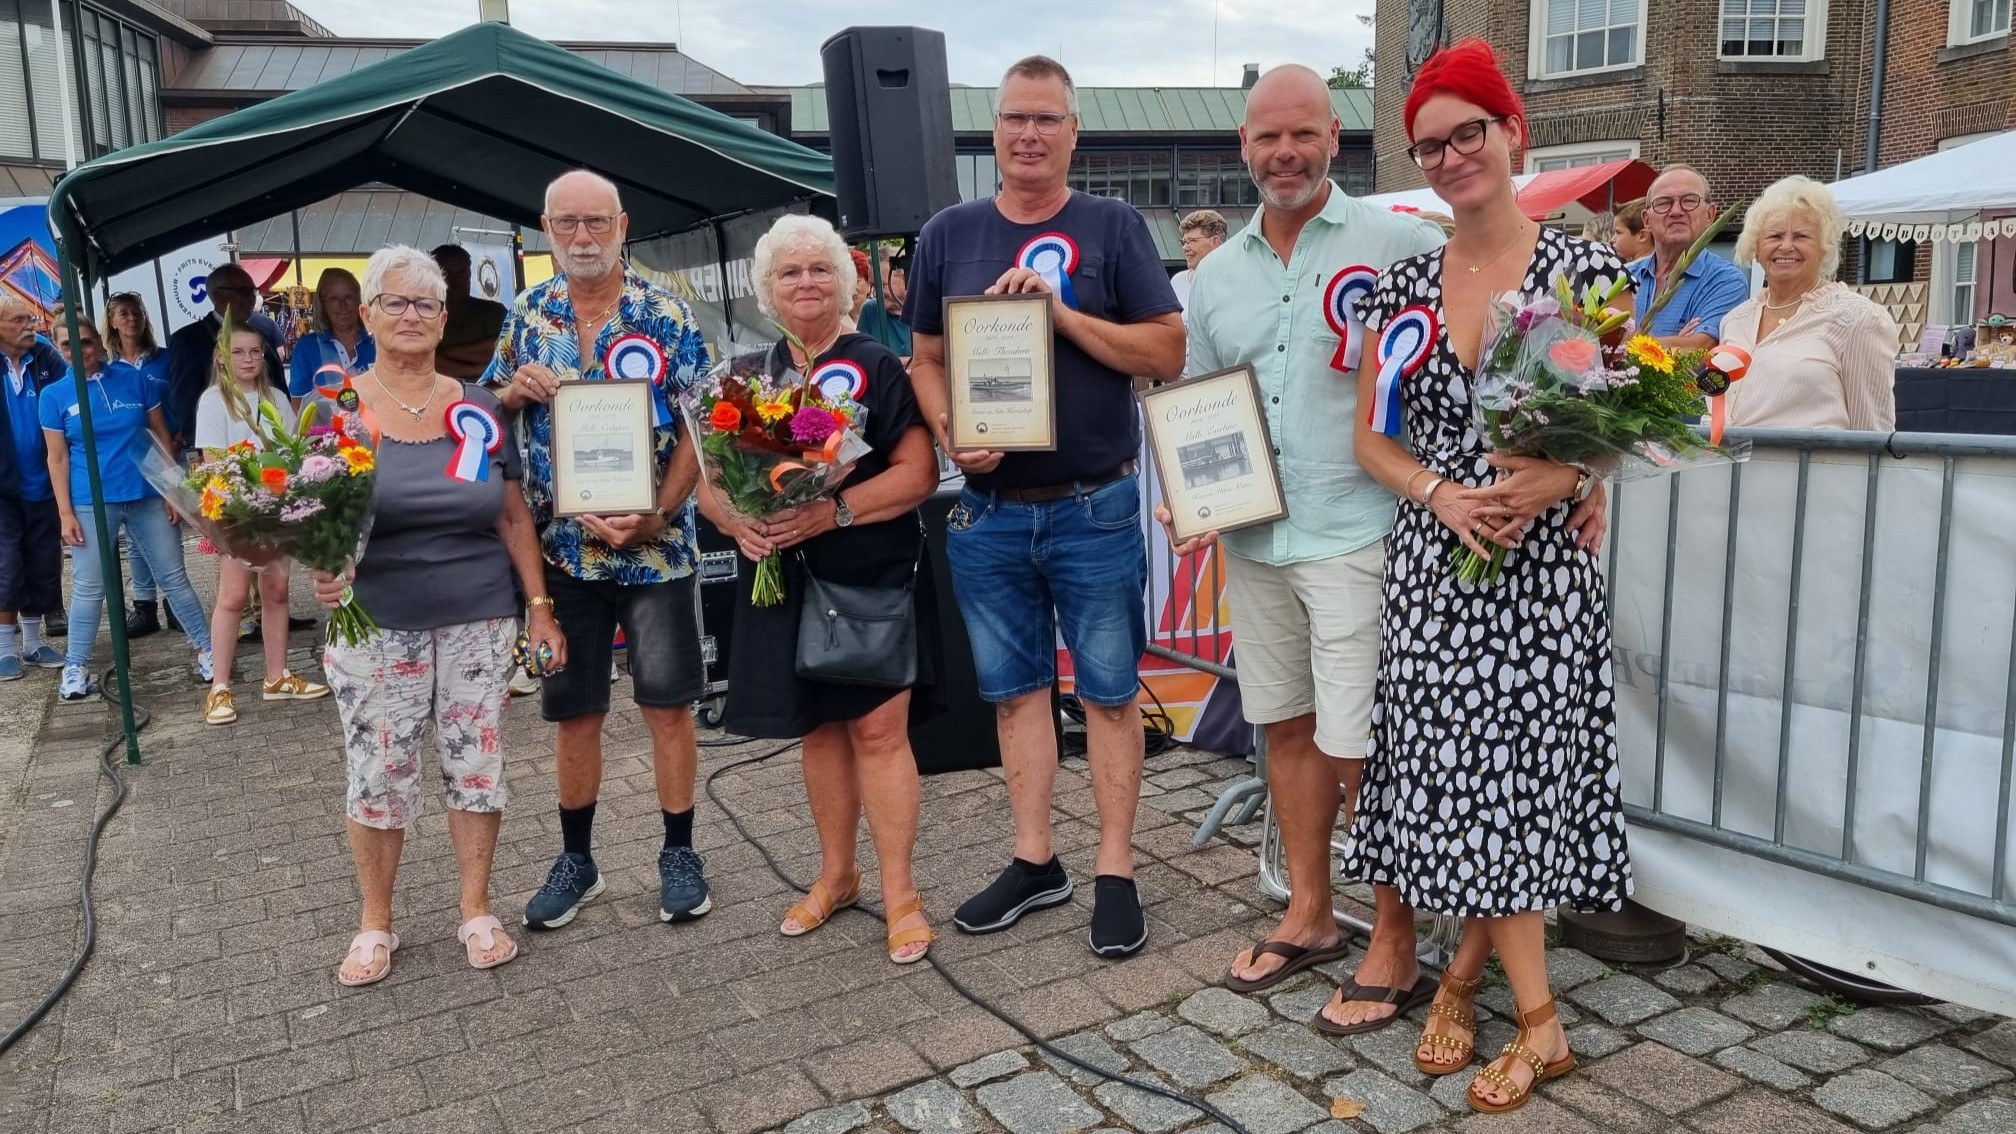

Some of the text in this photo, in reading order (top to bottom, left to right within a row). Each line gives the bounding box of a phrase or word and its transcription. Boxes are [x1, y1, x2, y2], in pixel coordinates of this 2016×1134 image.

[177, 258, 197, 273] FRITS
[964, 315, 1032, 334] Oorkonde
[569, 397, 634, 413] Oorkonde
[1166, 390, 1239, 422] Oorkonde
